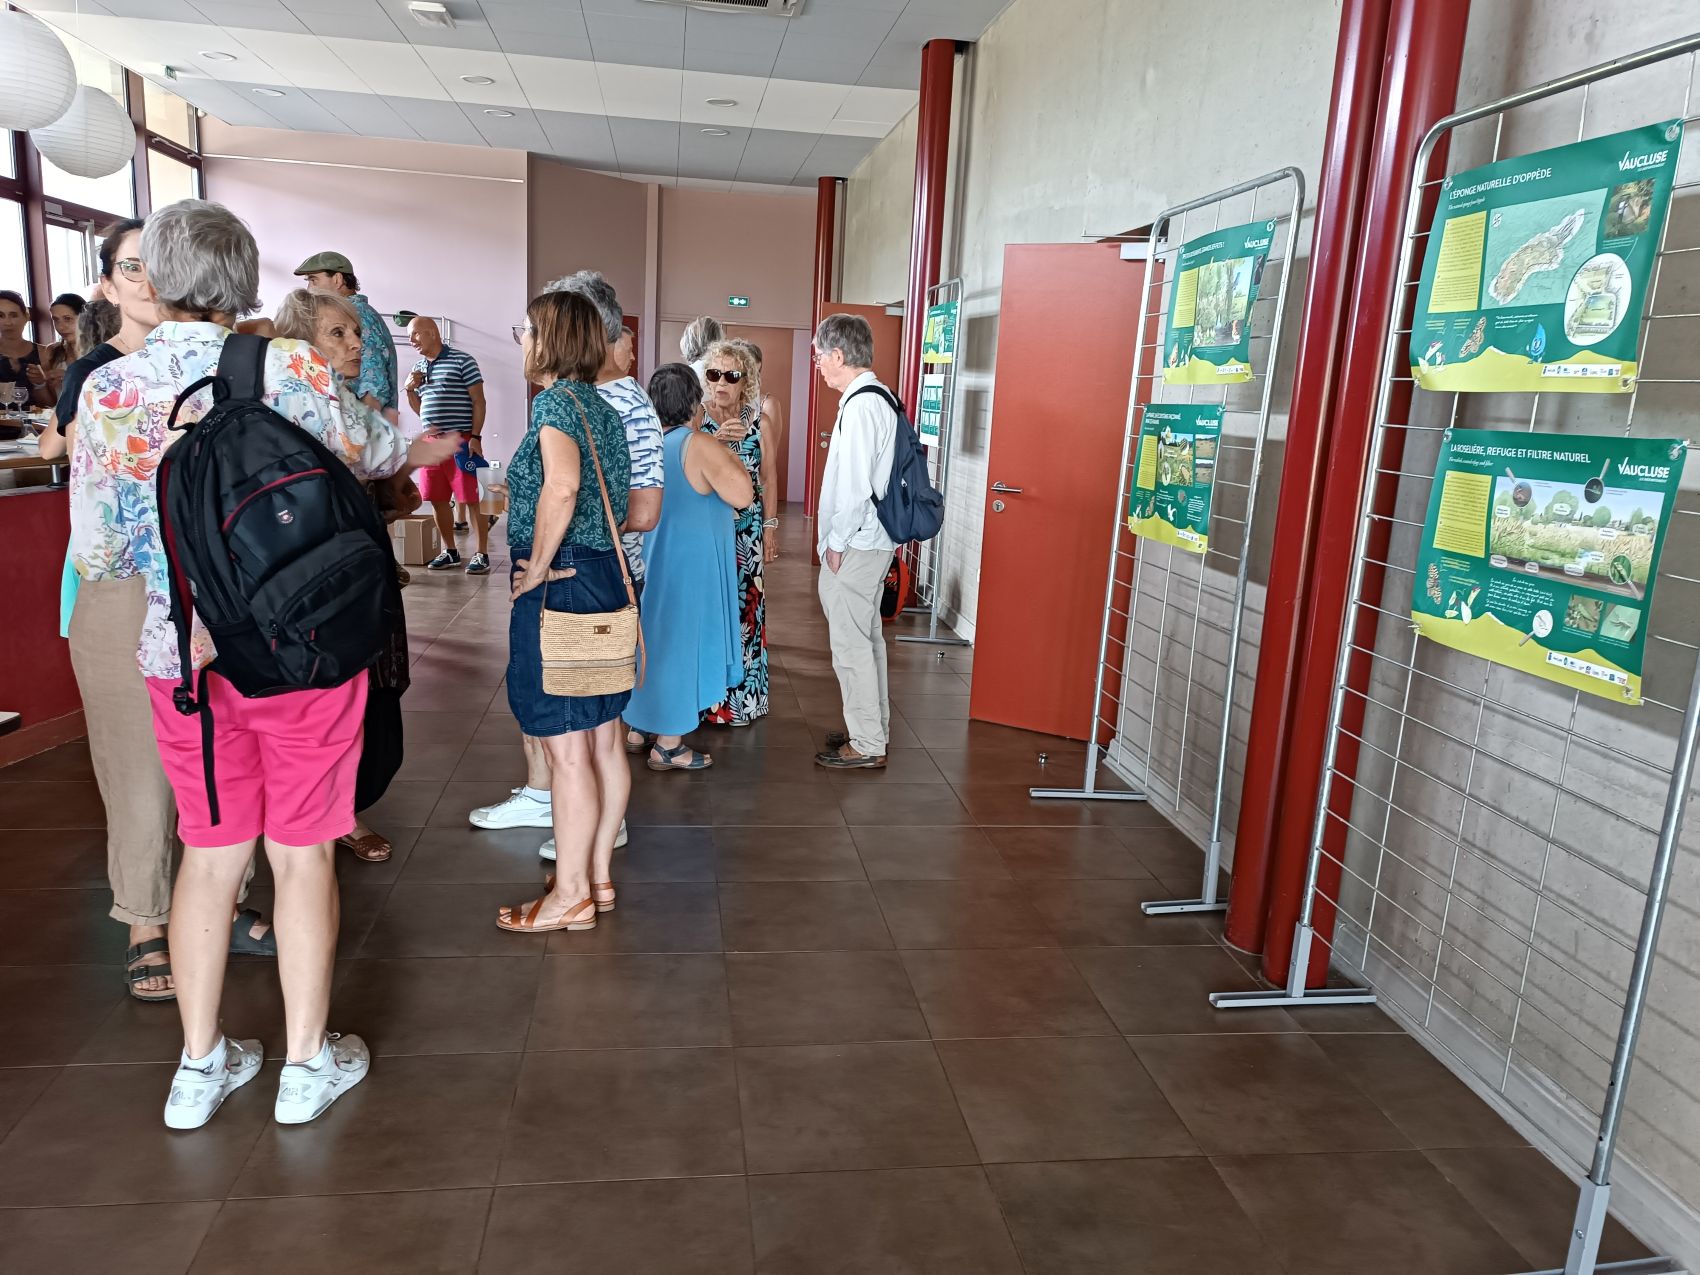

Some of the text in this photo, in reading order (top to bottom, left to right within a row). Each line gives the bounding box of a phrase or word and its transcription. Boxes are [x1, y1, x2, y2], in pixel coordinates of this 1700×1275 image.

[1618, 150, 1669, 171] VAUCLUSE
[1449, 167, 1552, 200] L'ÉPONGE NATURELLE D'OPPÈDE
[1456, 444, 1486, 457] ROSELIÈRE,
[1486, 446, 1517, 458] REFUGE
[1517, 448, 1527, 458] ET
[1527, 449, 1552, 460] FILTRE
[1553, 451, 1591, 463] NATUREL
[1618, 456, 1670, 478] VAUCLUSE
